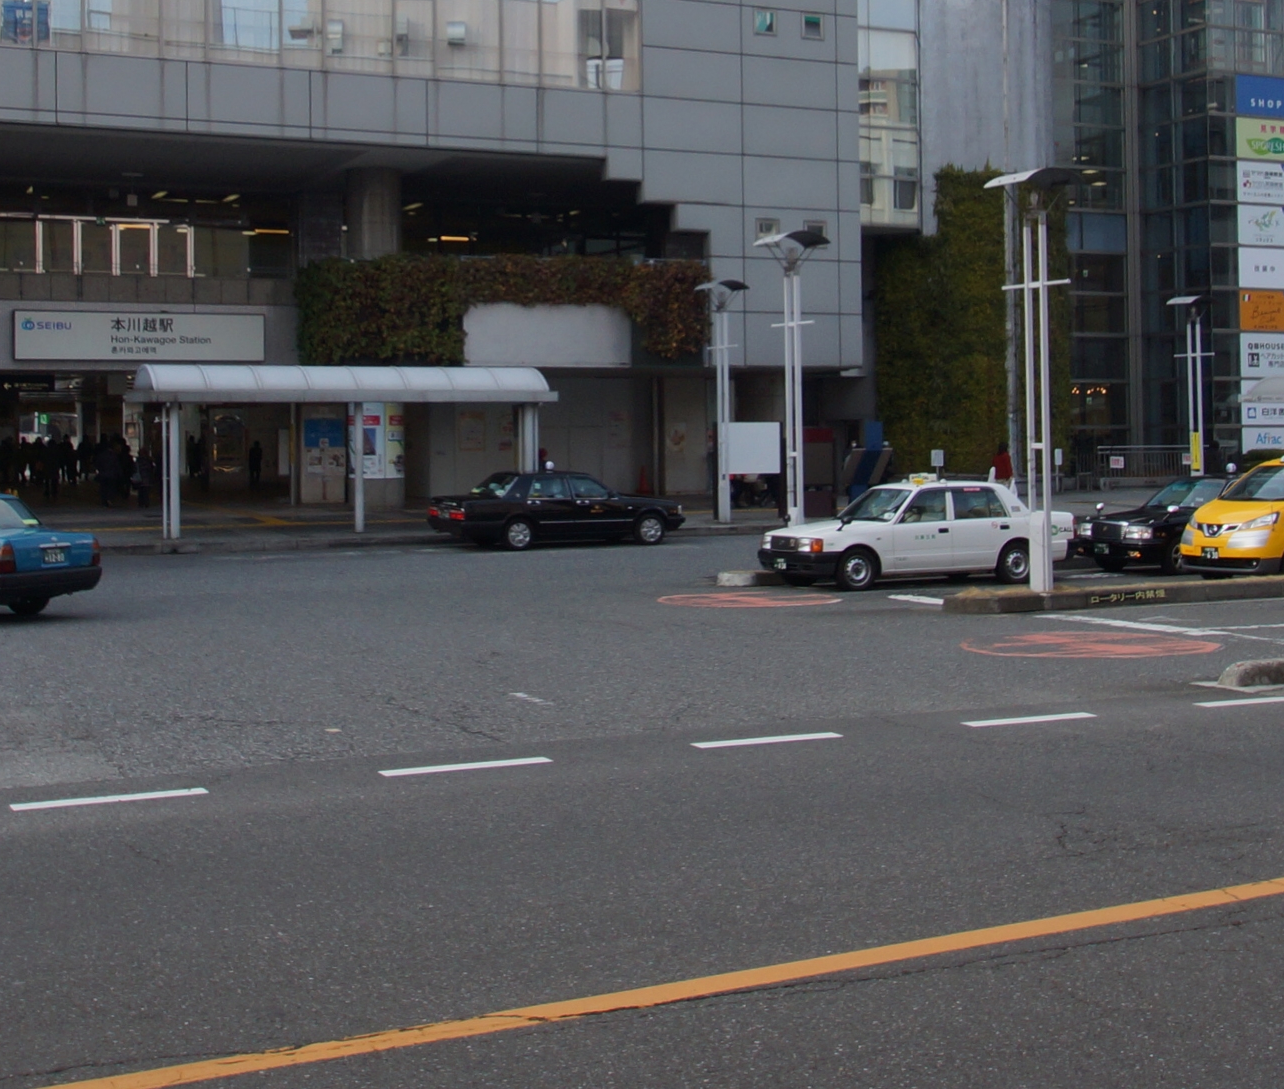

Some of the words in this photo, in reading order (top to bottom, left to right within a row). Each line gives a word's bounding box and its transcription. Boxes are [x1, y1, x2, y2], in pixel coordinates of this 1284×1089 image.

[1250, 98, 1283, 109] SHOP
[36, 320, 73, 331] SEIBU
[110, 317, 174, 333] 本川越駅
[111, 335, 177, 346] Hon-Kawagoe
[179, 335, 212, 345] Station
[1255, 432, 1282, 445] Aflac
[1090, 588, 1166, 604] ロータリー内禁煙
